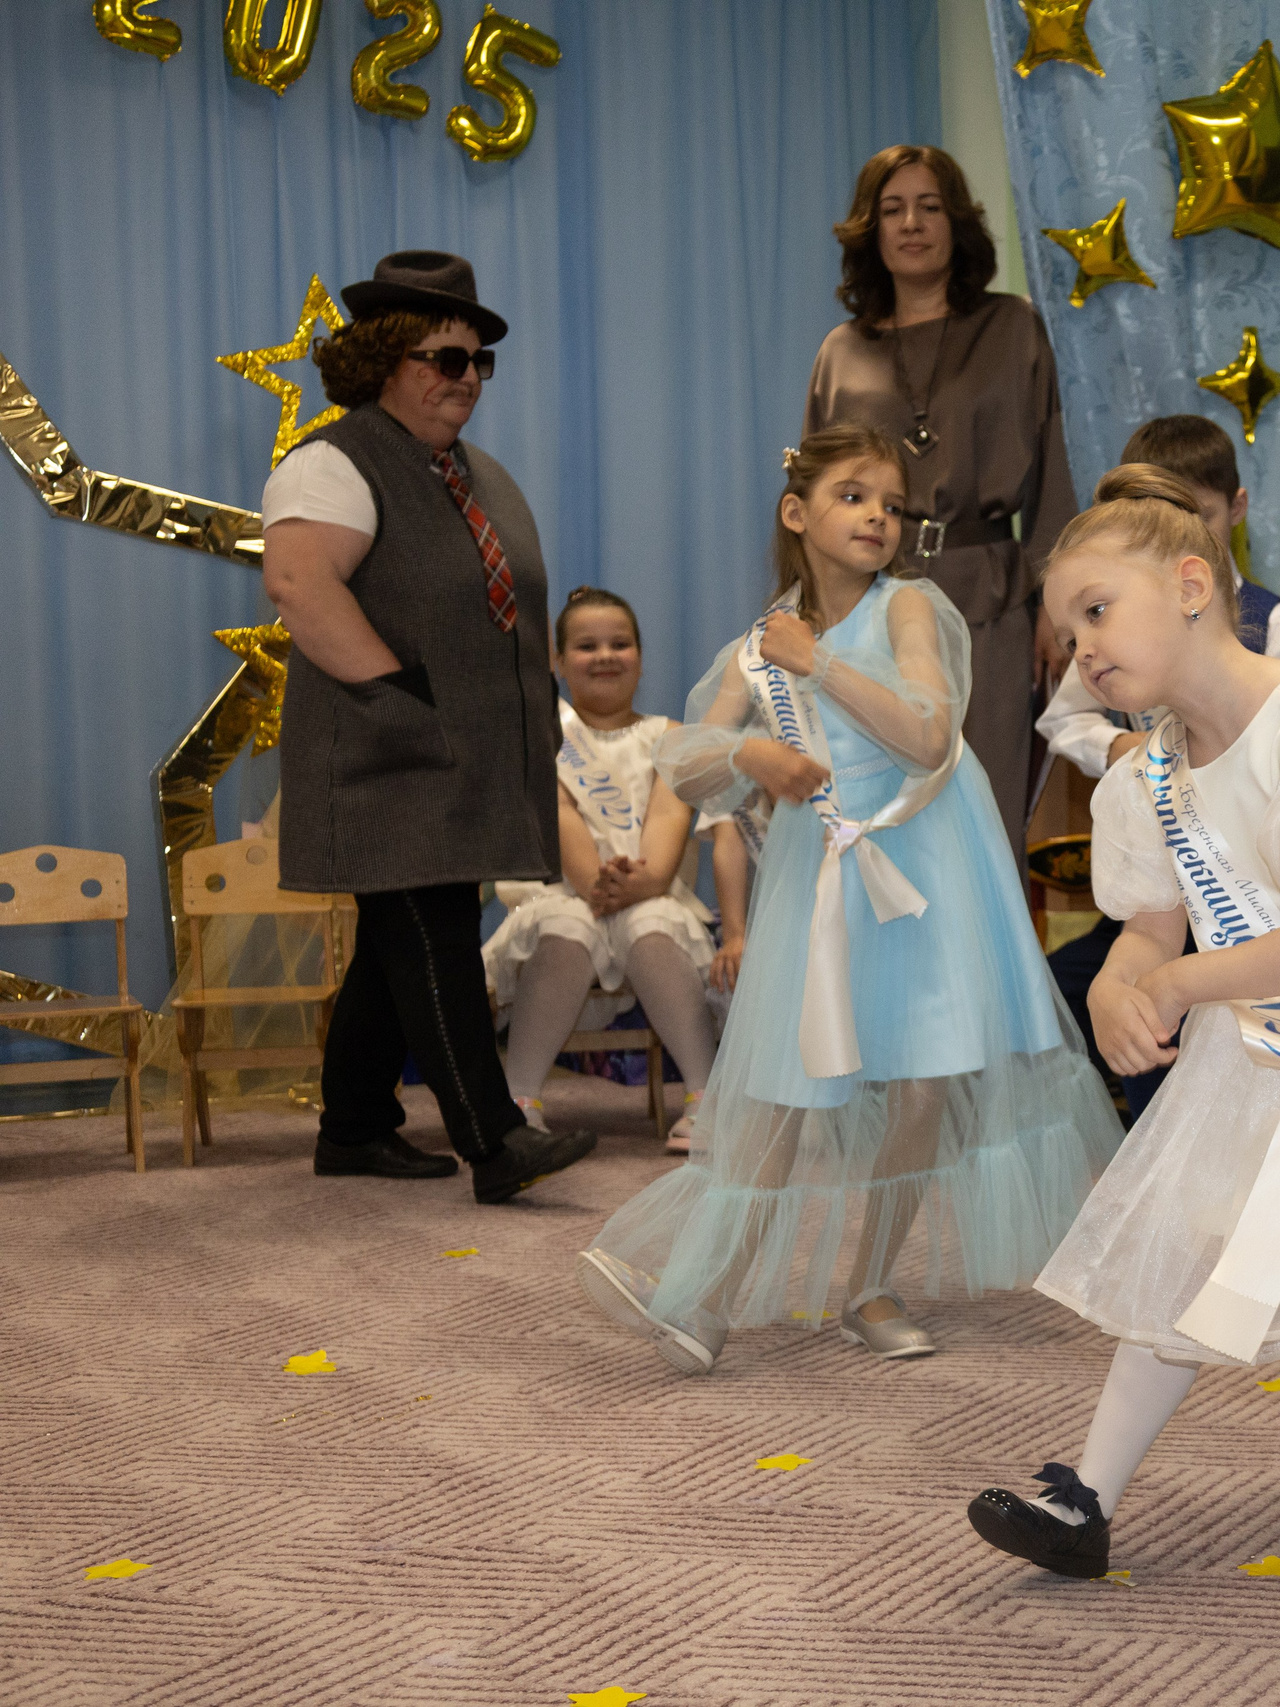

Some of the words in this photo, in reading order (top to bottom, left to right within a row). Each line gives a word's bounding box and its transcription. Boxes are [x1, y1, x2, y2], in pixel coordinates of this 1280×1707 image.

[1178, 783, 1234, 874] Березенская
[1235, 880, 1277, 932] Милан
[1190, 910, 1203, 925] 66
